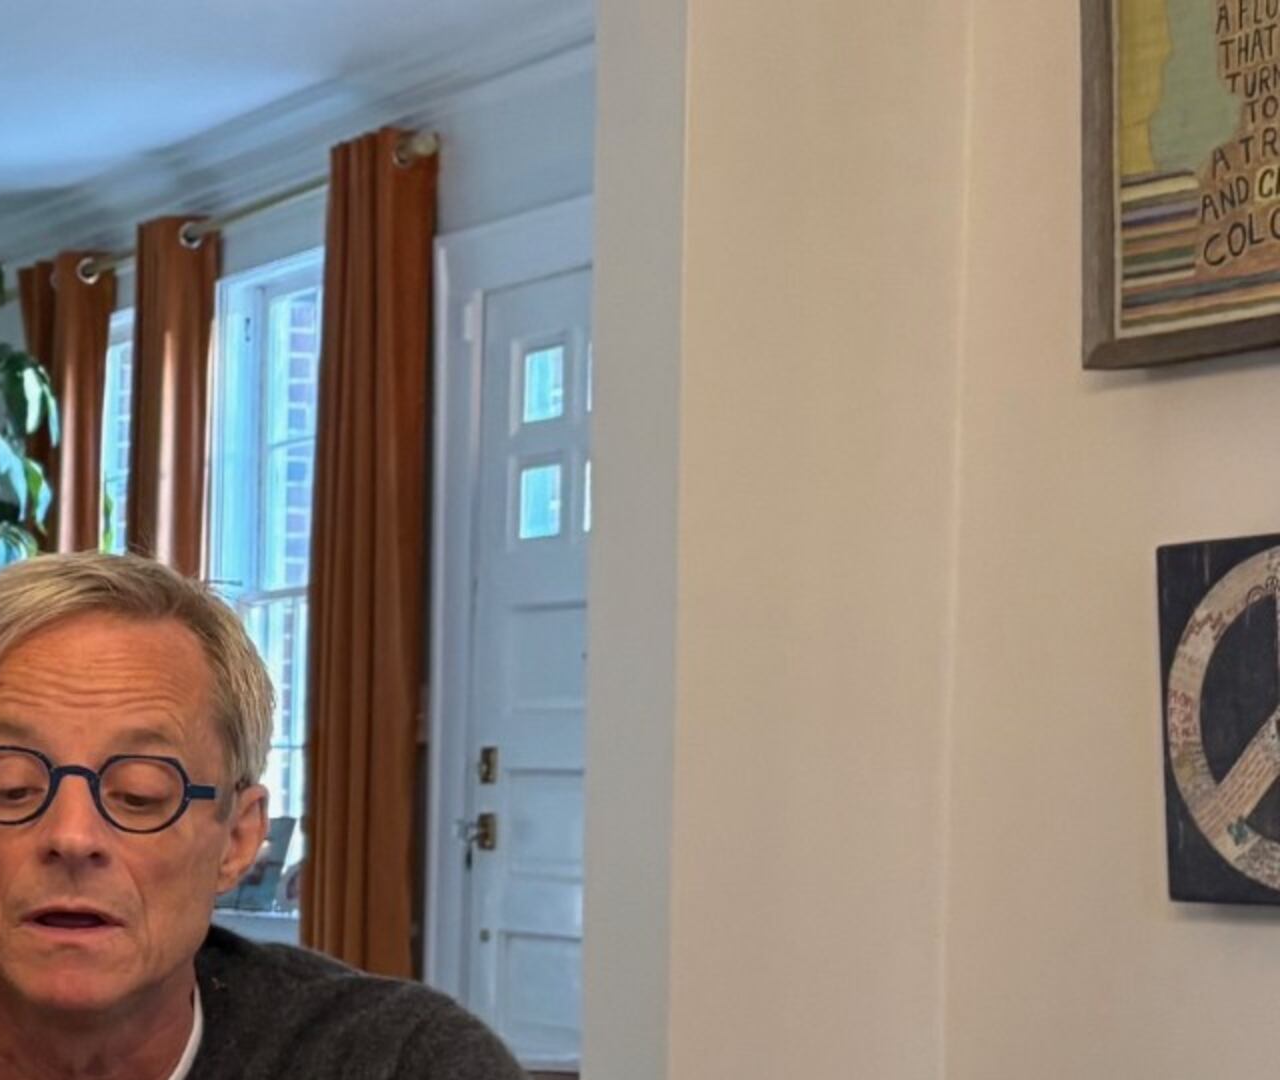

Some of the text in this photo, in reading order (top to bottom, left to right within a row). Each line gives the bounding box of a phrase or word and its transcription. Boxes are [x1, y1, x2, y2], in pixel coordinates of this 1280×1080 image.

[1216, 5, 1230, 34] A
[1219, 24, 1277, 70] THAT
[1244, 95, 1279, 123] TO
[1212, 147, 1230, 177] A
[1200, 177, 1249, 224] AND
